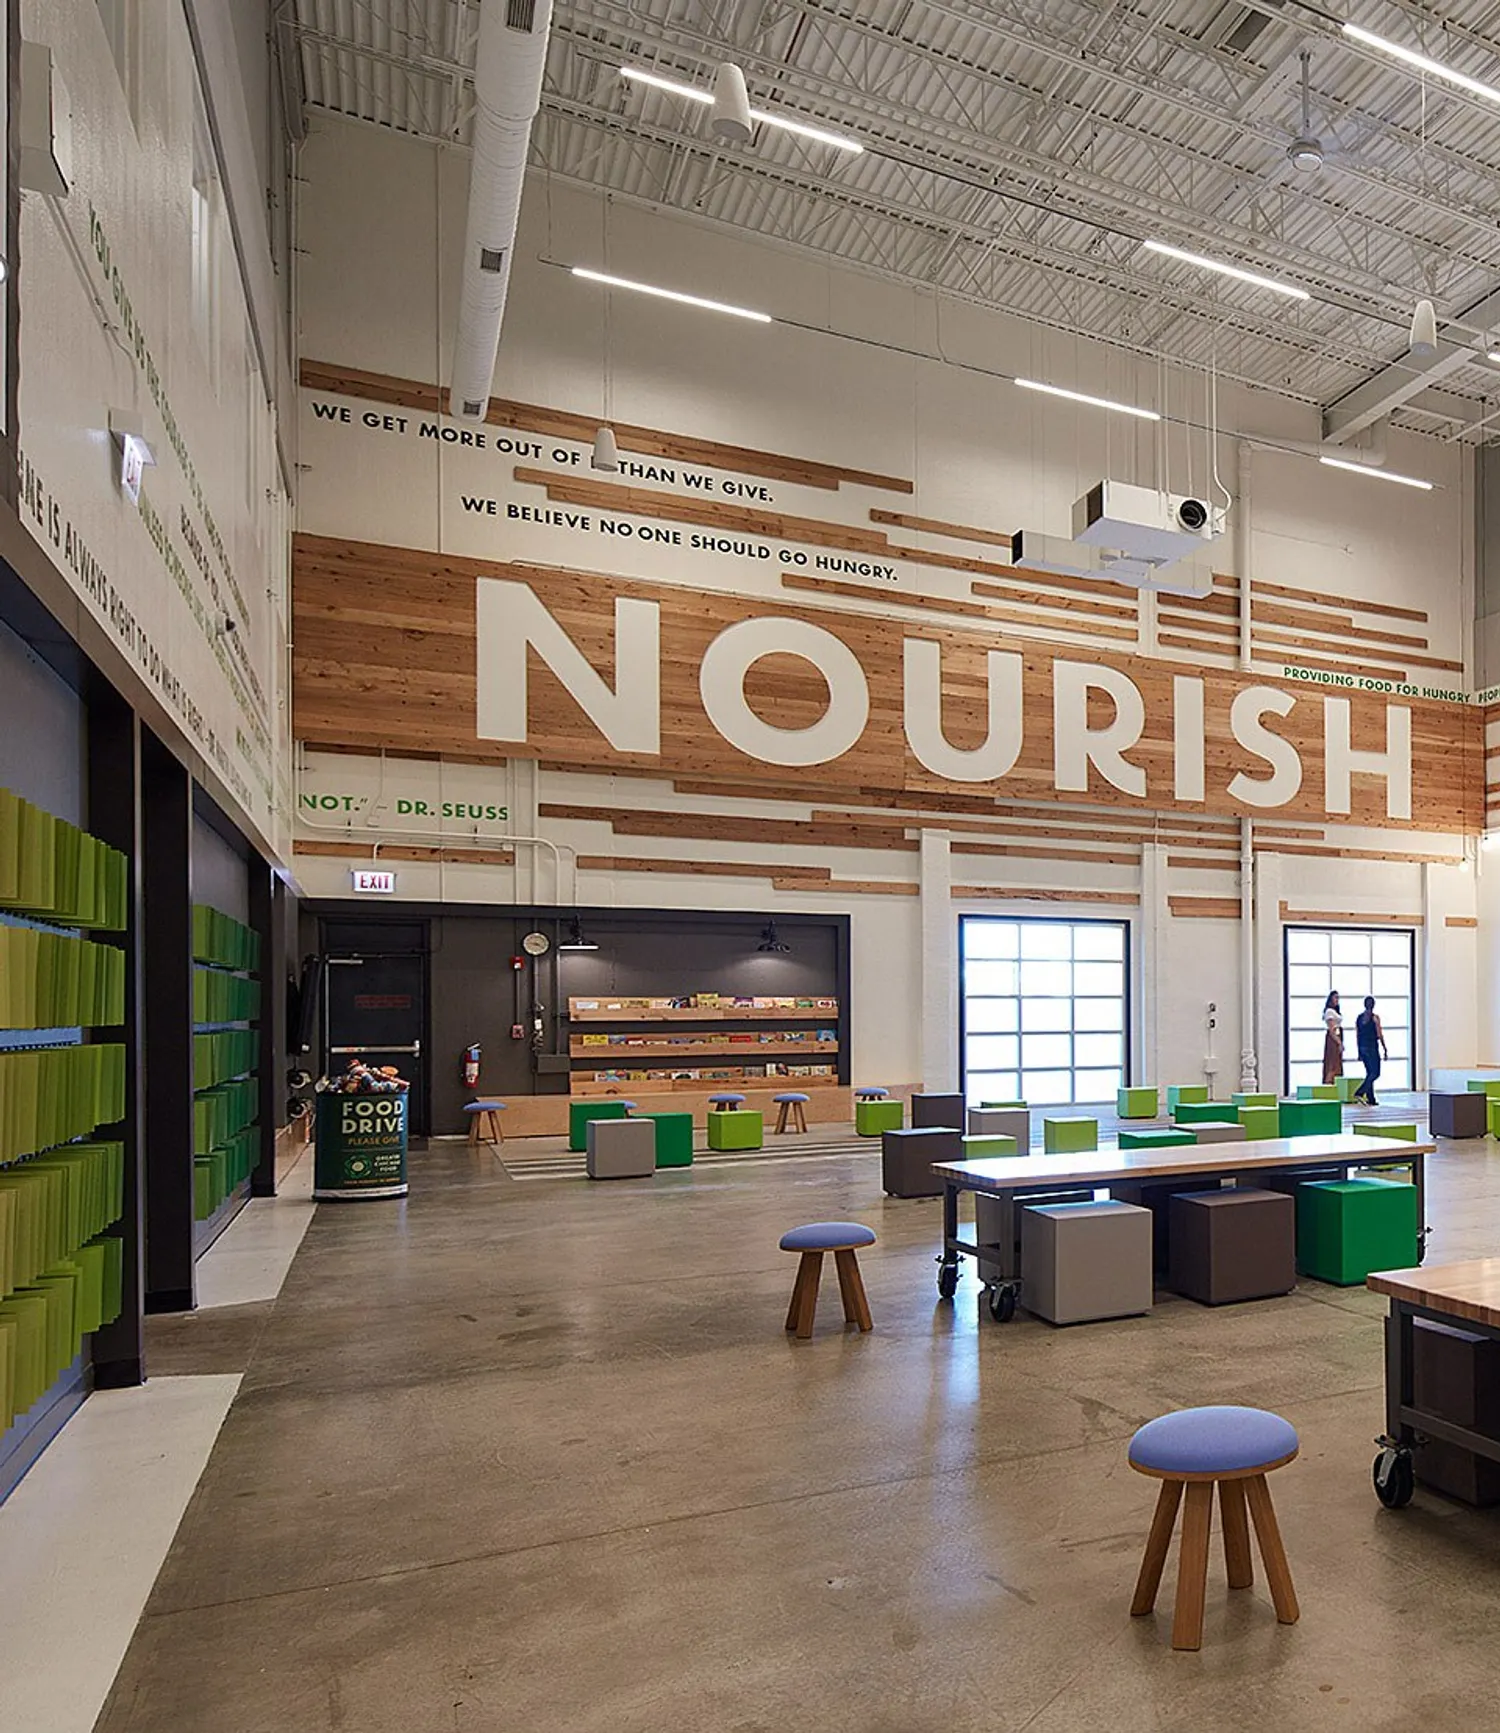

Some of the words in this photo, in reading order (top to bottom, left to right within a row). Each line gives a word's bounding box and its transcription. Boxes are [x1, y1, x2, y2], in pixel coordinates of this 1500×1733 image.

[312, 402, 351, 423] WE
[362, 412, 408, 433] GET
[419, 422, 486, 448] MORE
[496, 438, 542, 459] OUT
[552, 449, 581, 466] OF
[618, 460, 675, 483] THAN
[682, 473, 714, 491] WE
[722, 481, 774, 502] GIVE.
[48, 494, 60, 549] IS
[64, 521, 108, 612] ALWAYS
[461, 496, 497, 515] WE
[507, 504, 591, 531] BELIEVE
[599, 519, 633, 537] NO
[637, 526, 682, 546] ONE
[690, 534, 771, 559] SHOULD
[778, 549, 808, 566] GO
[815, 555, 898, 582] HUNGRY.
[476, 575, 1413, 822] NOURISH
[1283, 667, 1355, 687] PROVIDING
[1358, 677, 1392, 693] FOOD
[1396, 684, 1419, 696] FOR
[1423, 687, 1471, 703] HUNGRY
[397, 799, 436, 816] DR.
[442, 802, 509, 821] SEUSS
[359, 873, 390, 889] EXIT
[342, 1100, 404, 1117] FOOD
[342, 1117, 404, 1134] DRIVE
